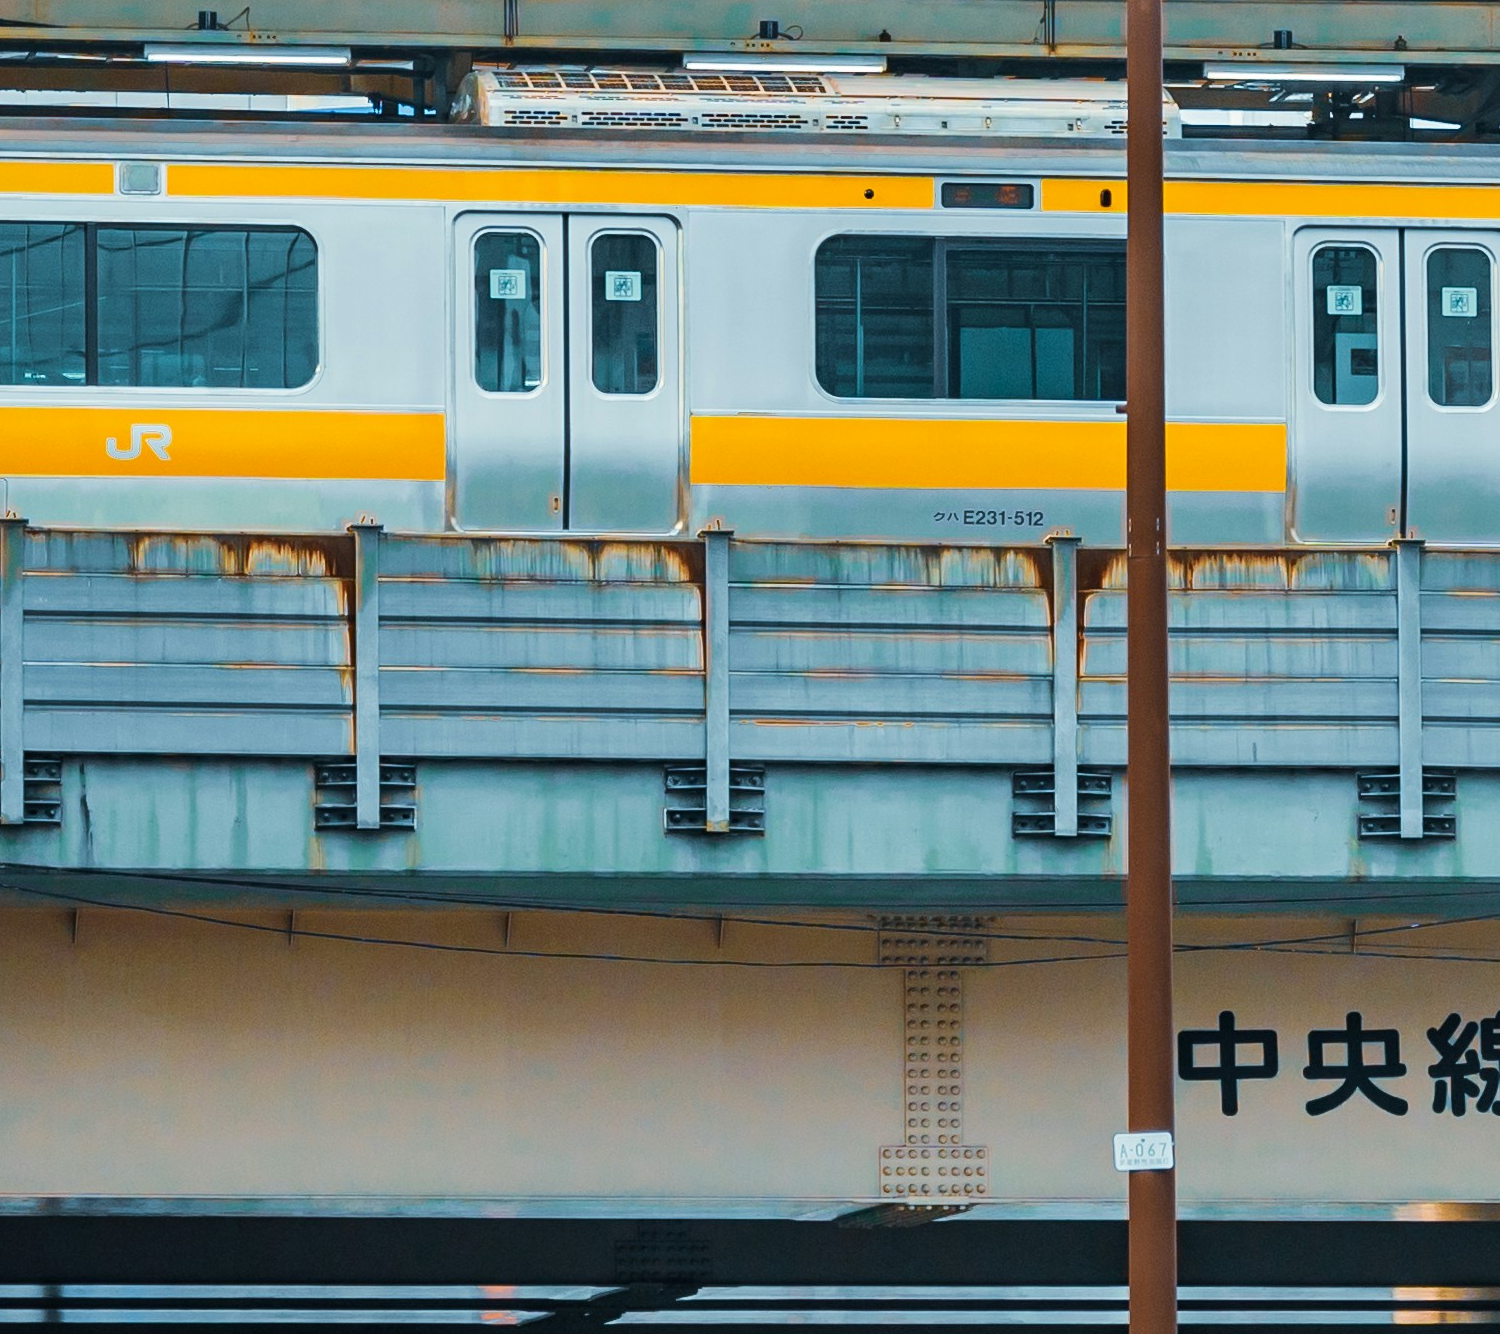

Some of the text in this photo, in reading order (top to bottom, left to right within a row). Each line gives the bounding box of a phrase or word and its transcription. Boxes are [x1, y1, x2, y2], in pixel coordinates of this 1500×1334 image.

[106, 423, 172, 460] JR
[933, 510, 1044, 526] クハ E231-512
[1120, 1142, 1167, 1158] A-067
